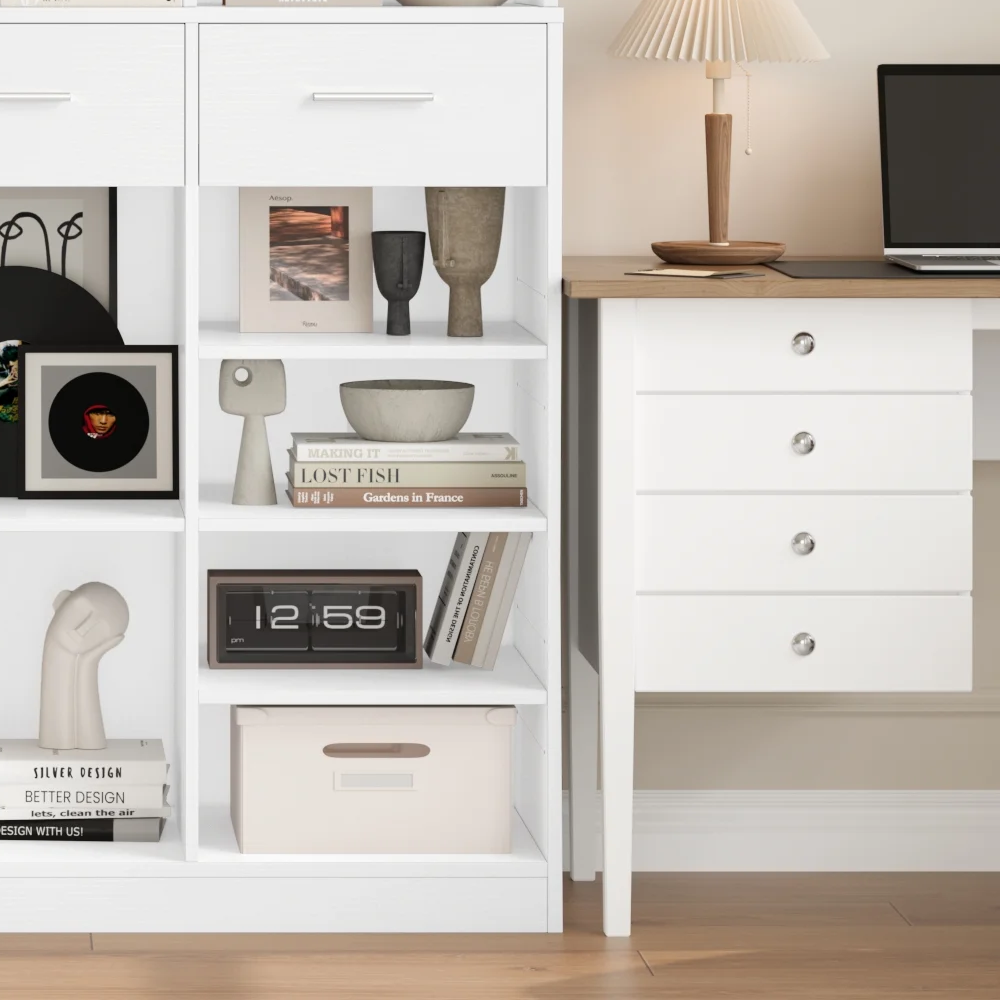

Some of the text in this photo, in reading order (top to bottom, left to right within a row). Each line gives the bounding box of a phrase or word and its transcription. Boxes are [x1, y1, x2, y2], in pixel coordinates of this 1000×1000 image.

[308, 448, 363, 459] MAKING
[366, 448, 381, 458] IT
[301, 468, 400, 483] LOST FISH
[363, 492, 464, 503] Gardens in France
[255, 604, 386, 630] 12 59
[33, 766, 123, 779] SILVER DESIGN
[25, 790, 125, 804] BETTER DESIGN
[31, 808, 135, 818] lets, clean the air
[36, 826, 63, 836] WITH
[66, 826, 84, 836] US!
